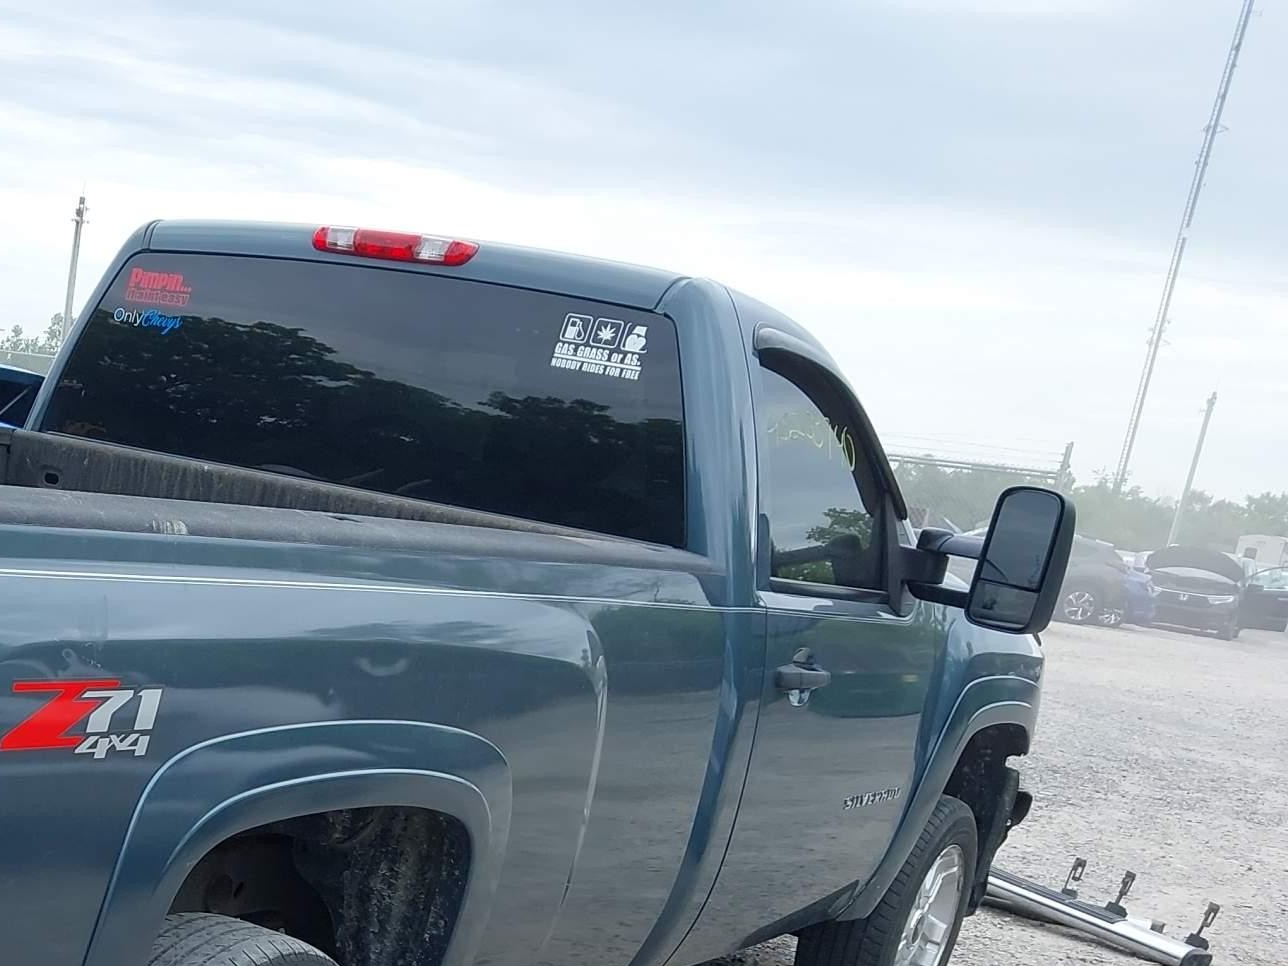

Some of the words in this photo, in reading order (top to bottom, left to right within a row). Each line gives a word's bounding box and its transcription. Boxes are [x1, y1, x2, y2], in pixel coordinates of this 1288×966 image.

[577, 346, 609, 361] GRASS
[611, 353, 623, 363] or
[551, 357, 581, 371] NOBODY
[582, 362, 605, 375] RIDES
[605, 367, 620, 378] FOR
[621, 369, 641, 380] FREE
[0, 680, 163, 752] Z71
[842, 786, 902, 811] SILVERADO
